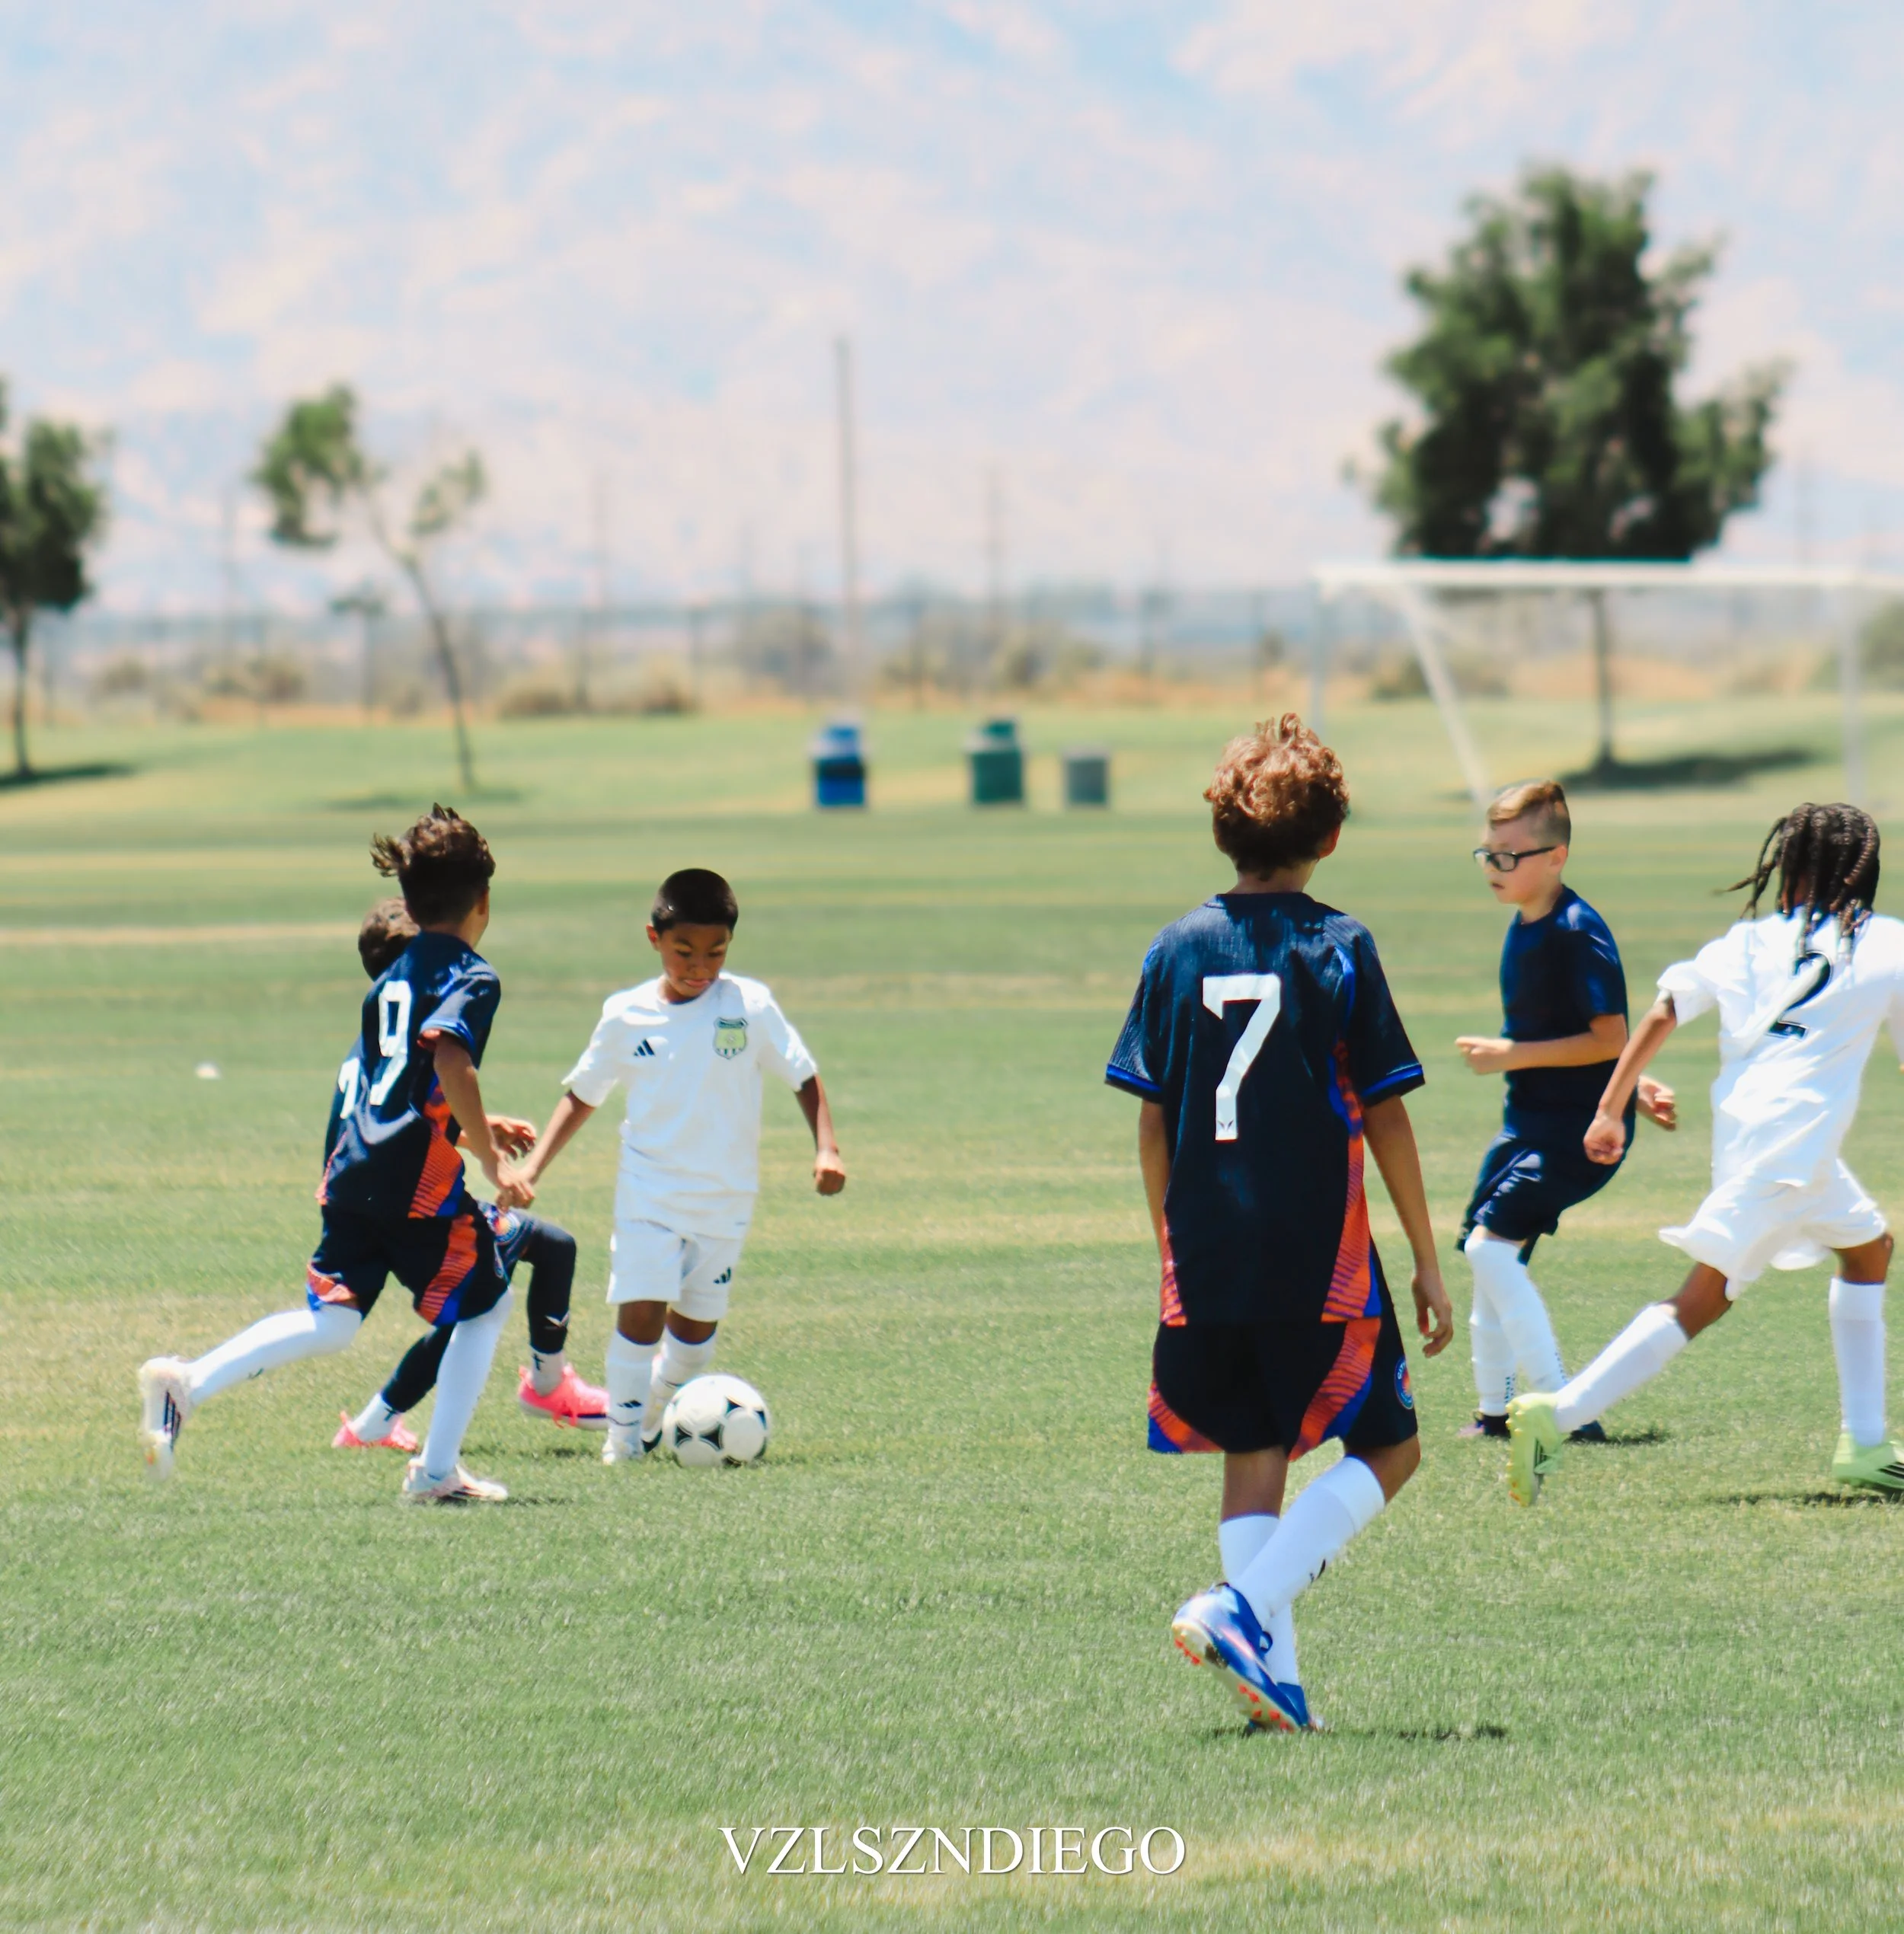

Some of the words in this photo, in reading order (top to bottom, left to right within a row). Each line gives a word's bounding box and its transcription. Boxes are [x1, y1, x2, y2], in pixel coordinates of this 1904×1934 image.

[369, 979, 411, 1106] 9
[1203, 974, 1281, 1141] 7
[1766, 950, 1832, 1041] 2
